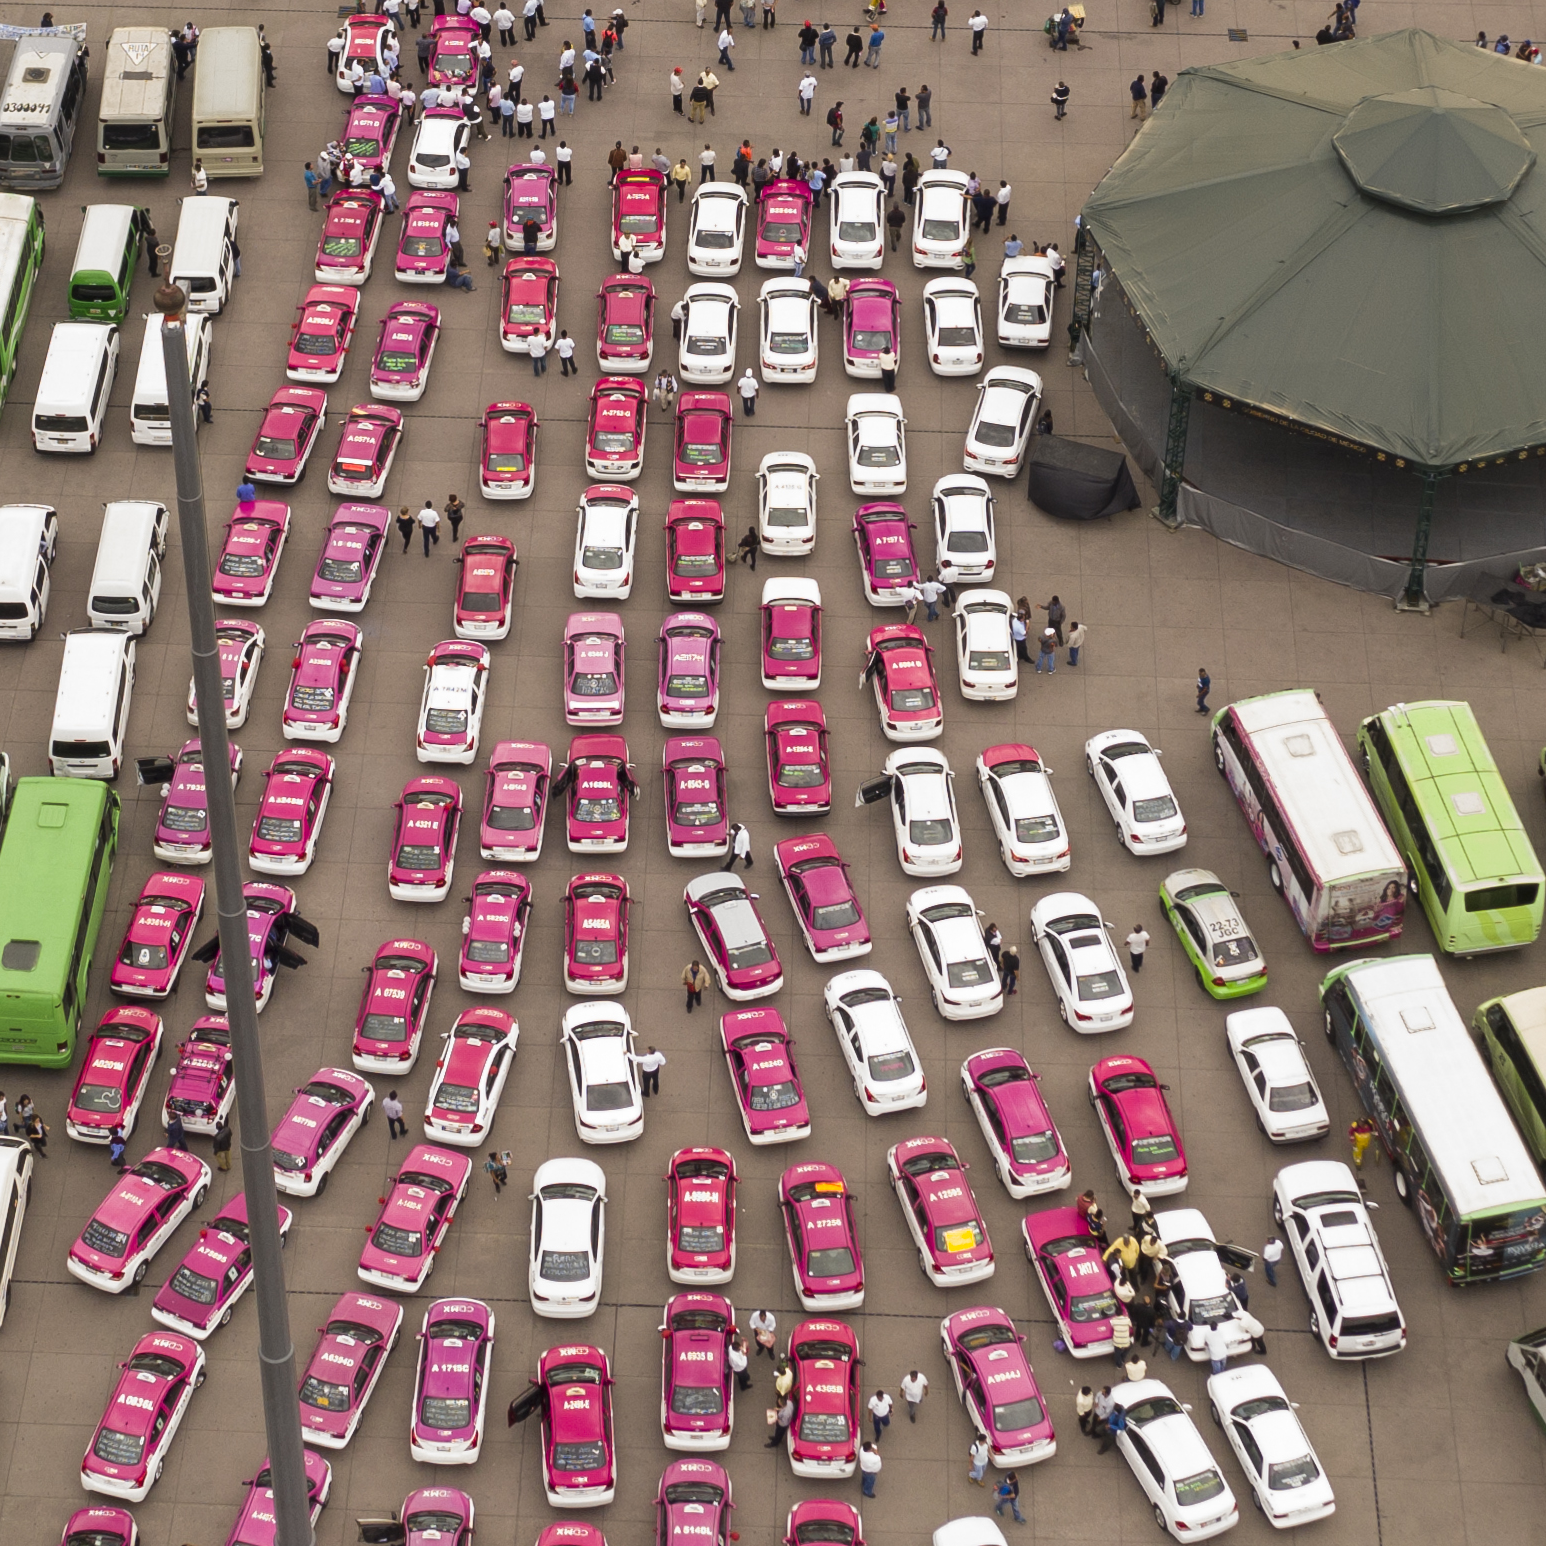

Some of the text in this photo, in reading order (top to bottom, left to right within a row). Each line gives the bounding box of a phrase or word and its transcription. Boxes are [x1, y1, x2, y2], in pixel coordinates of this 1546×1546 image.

[128, 43, 150, 52] RUTA
[1290, 422, 1298, 430] LA
[1328, 436, 1338, 444] DE
[408, 820, 414, 828] A
[1210, 919, 1239, 932] 22-73
[1217, 926, 1239, 937] JGC
[375, 988, 381, 996] A
[906, 1138, 934, 1147] CDMX
[423, 1154, 452, 1166] CDMX
[357, 1299, 382, 1309] CDMX
[960, 1310, 989, 1321] CDMX
[153, 1339, 182, 1350] CDMX
[559, 1347, 589, 1356] CDMX
[680, 1352, 687, 1360] A
[432, 1364, 470, 1372] A 1715C
[557, 1528, 588, 1536] CDMX
[674, 1526, 682, 1534] A
